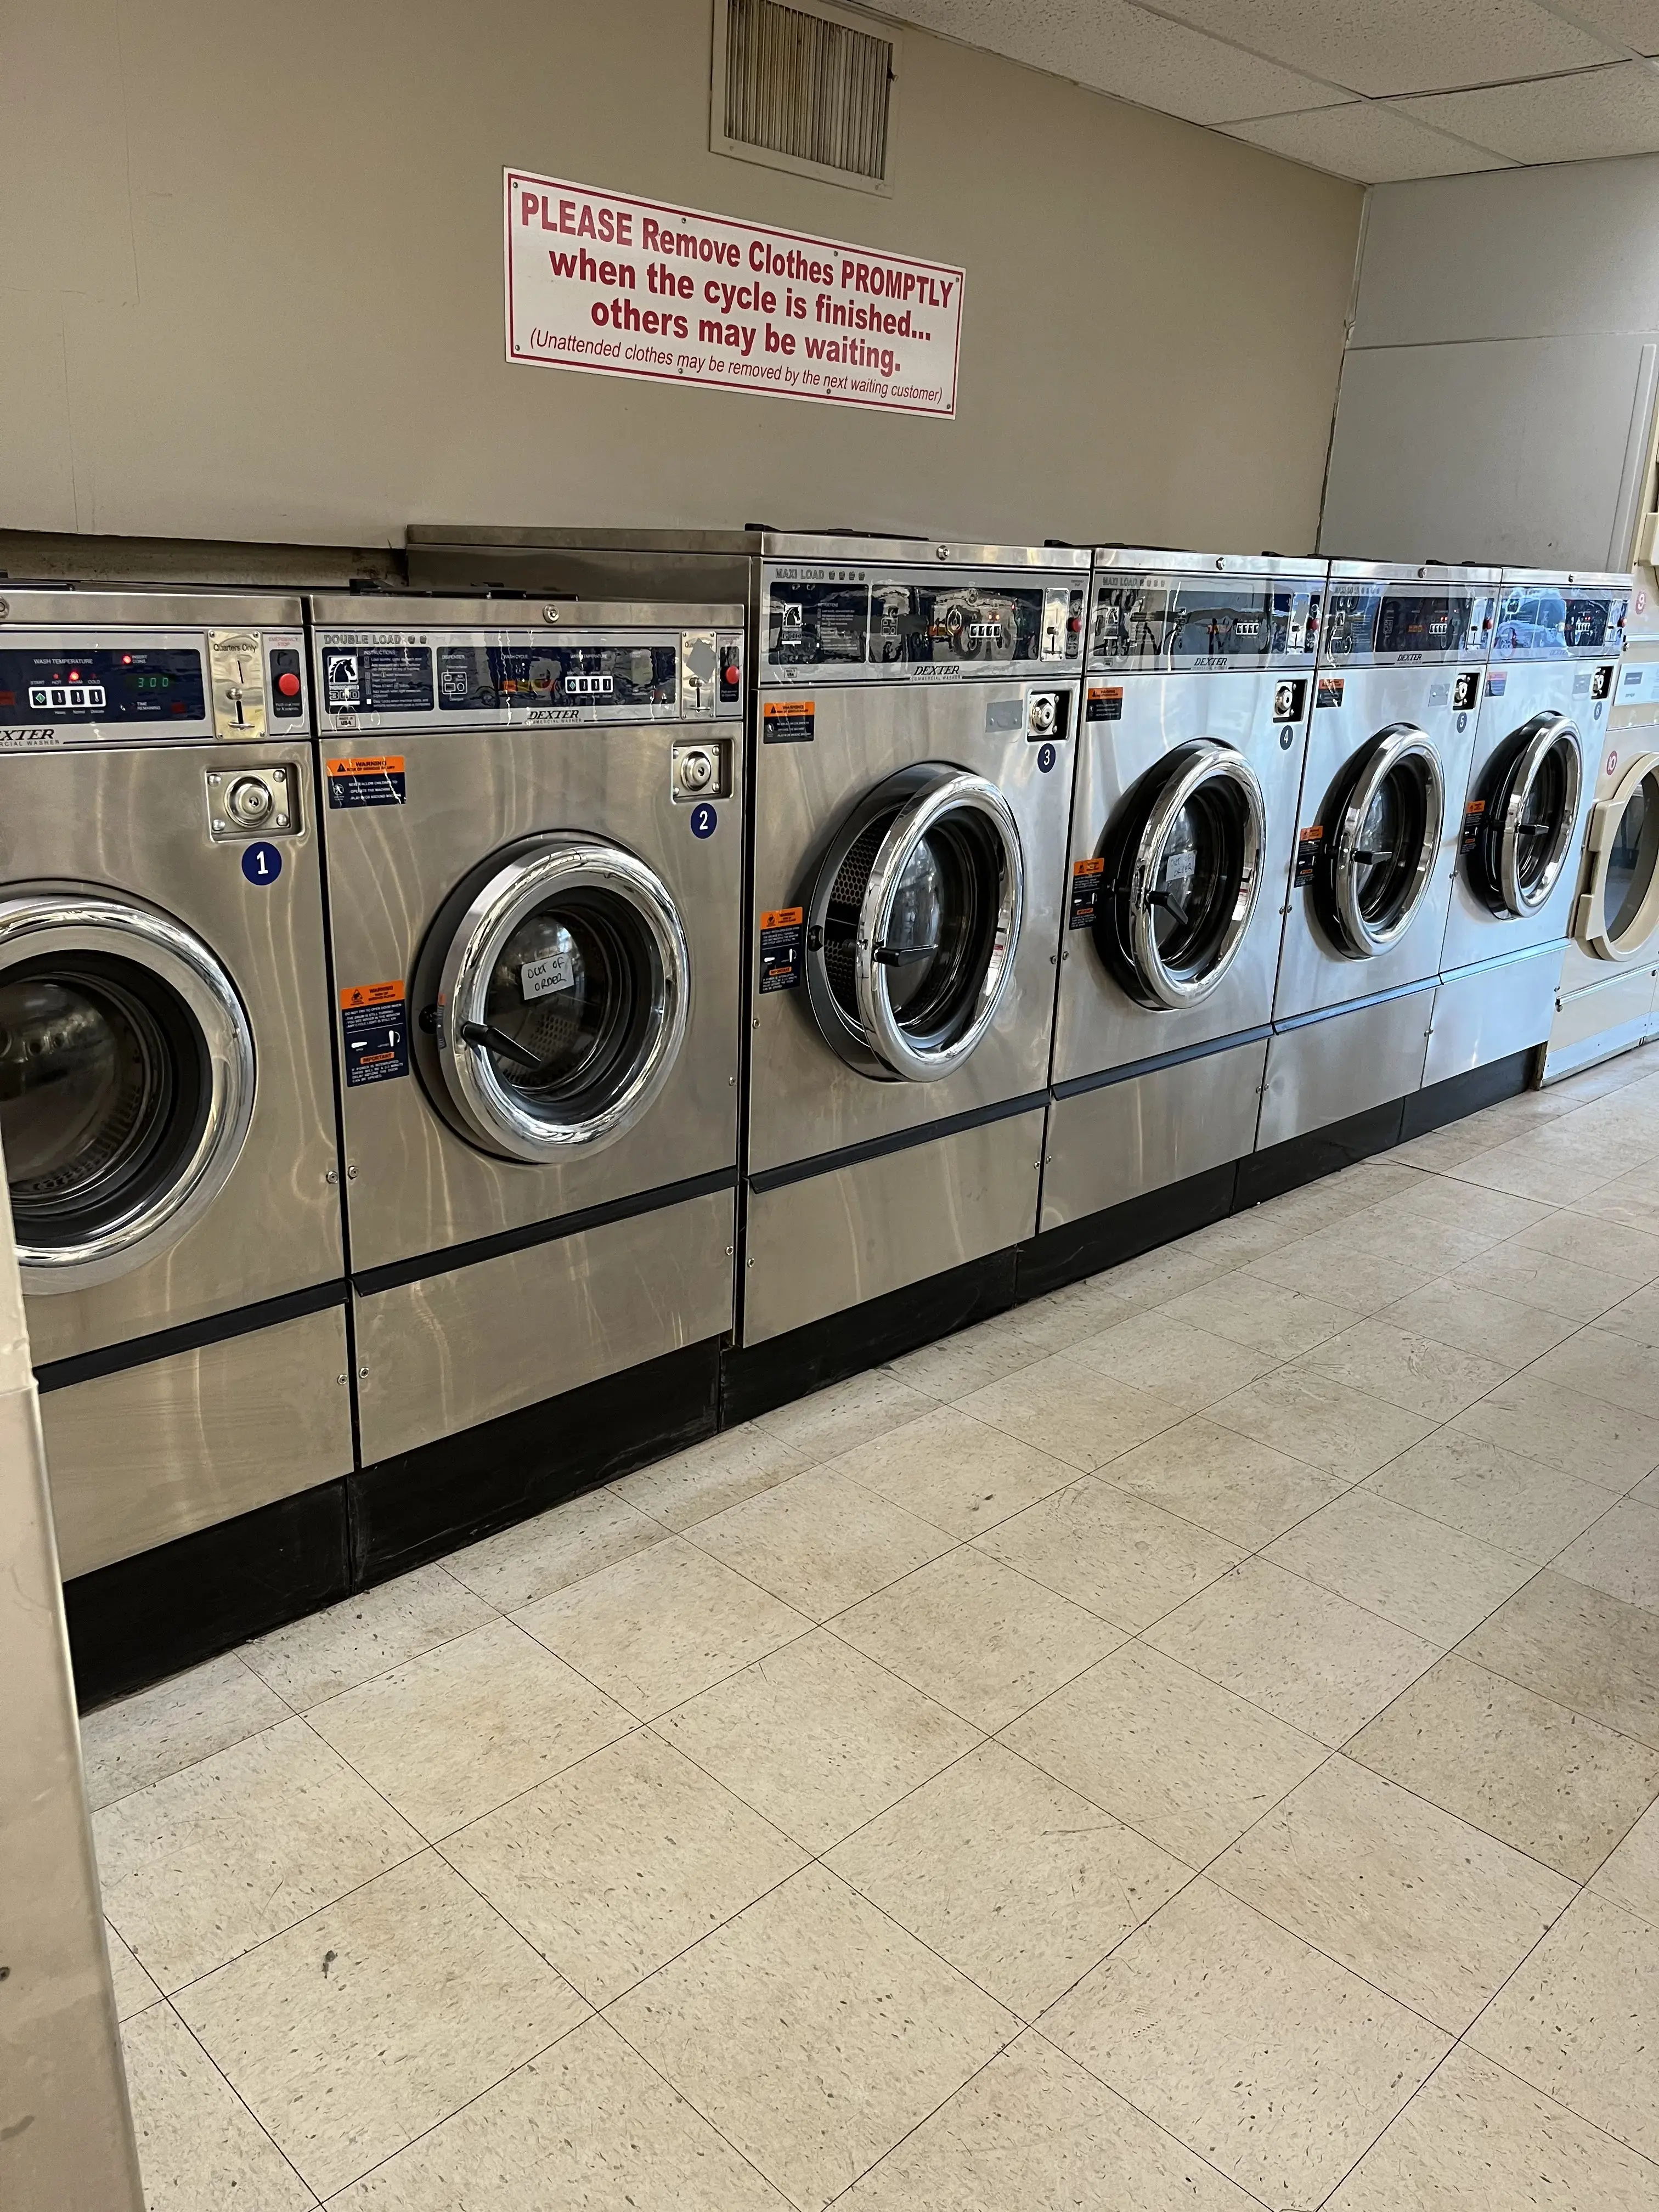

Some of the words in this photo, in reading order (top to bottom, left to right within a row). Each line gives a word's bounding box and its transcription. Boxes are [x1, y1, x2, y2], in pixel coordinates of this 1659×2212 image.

[521, 192, 633, 246] PLEASE
[642, 218, 741, 267] Remove
[748, 241, 833, 286] Clothes
[841, 260, 953, 308] PROMPTLY
[549, 251, 635, 290] when
[646, 262, 694, 299] the
[704, 280, 776, 314] cycle
[786, 287, 807, 319] is
[816, 294, 931, 340] finished...
[591, 298, 689, 339] others
[699, 320, 756, 357] may
[765, 322, 795, 355] be
[805, 336, 900, 377] waiting.
[530, 328, 621, 358] (Unattended
[624, 344, 673, 365] clothes
[676, 354, 706, 374] may
[709, 355, 725, 373] be
[728, 362, 782, 380] removed
[785, 366, 799, 386] by
[802, 369, 820, 386] the
[823, 375, 848, 390] next
[851, 379, 888, 398] waiting
[891, 385, 943, 405] customer)
[776, 568, 797, 579] MAXI
[800, 569, 825, 580] LOAD
[1103, 577, 1118, 585] MAXI
[1120, 577, 1137, 586] LOAD
[1638, 594, 1644, 610] 9
[324, 634, 368, 645] DOUBLE
[373, 635, 402, 645] LOAD
[242, 644, 257, 652] Only
[1194, 658, 1227, 666] DEXTER
[1397, 653, 1422, 662] DEXTER
[913, 665, 960, 675] DEXTER
[527, 710, 579, 720] DEXTER
[1596, 705, 1600, 716] 6
[1459, 715, 1464, 727] 5
[1284, 730, 1288, 743] 4
[1043, 749, 1050, 765] 3
[1607, 755, 1616, 771] 10
[699, 810, 708, 830] 2
[257, 851, 268, 874] 1
[528, 962, 548, 979] OUT
[552, 957, 565, 969] OF
[534, 973, 567, 991] ORDER
[363, 1053, 392, 1063] IMPORTANT
